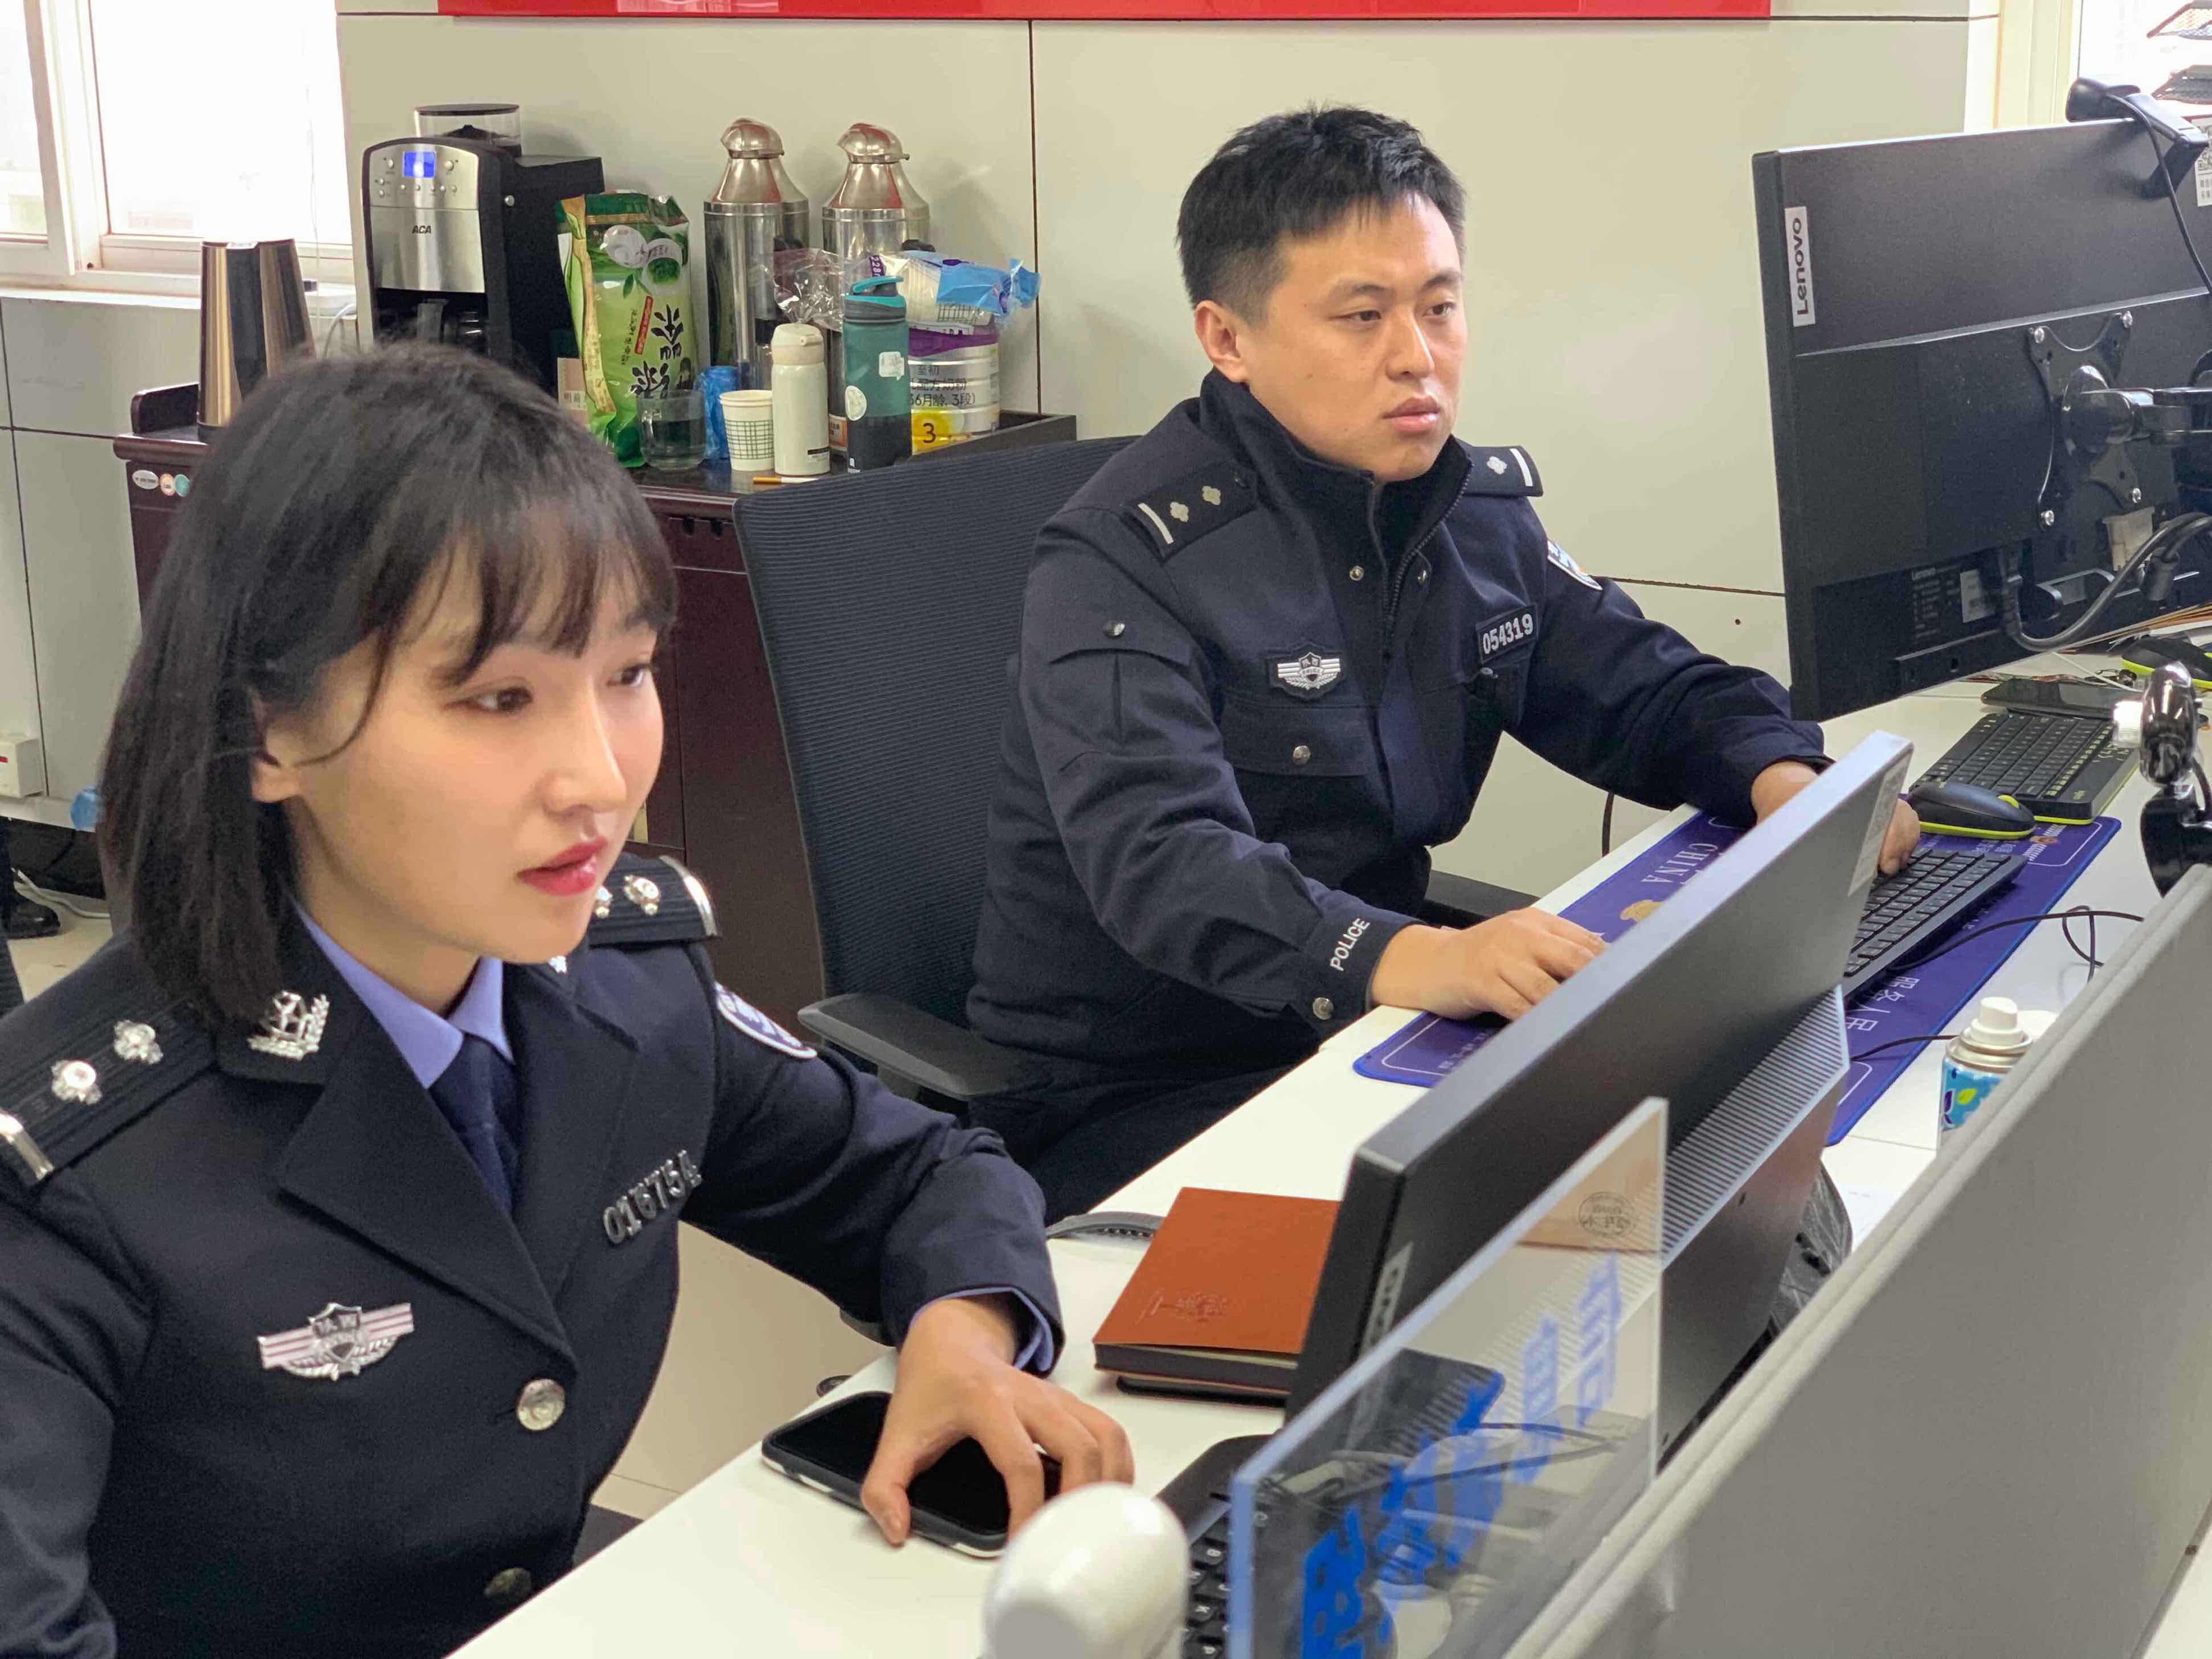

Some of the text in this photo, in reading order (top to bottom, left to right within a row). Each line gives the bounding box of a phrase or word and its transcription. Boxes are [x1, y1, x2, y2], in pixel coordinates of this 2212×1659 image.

[411, 225, 432, 234] ACA
[1792, 217, 1809, 315] Lenovo
[922, 423, 936, 444] 3
[1482, 614, 1534, 655] 054319
[1641, 843, 1719, 882] CHINA
[1330, 918, 1371, 971] POLICE
[603, 1149, 702, 1244] 016754
